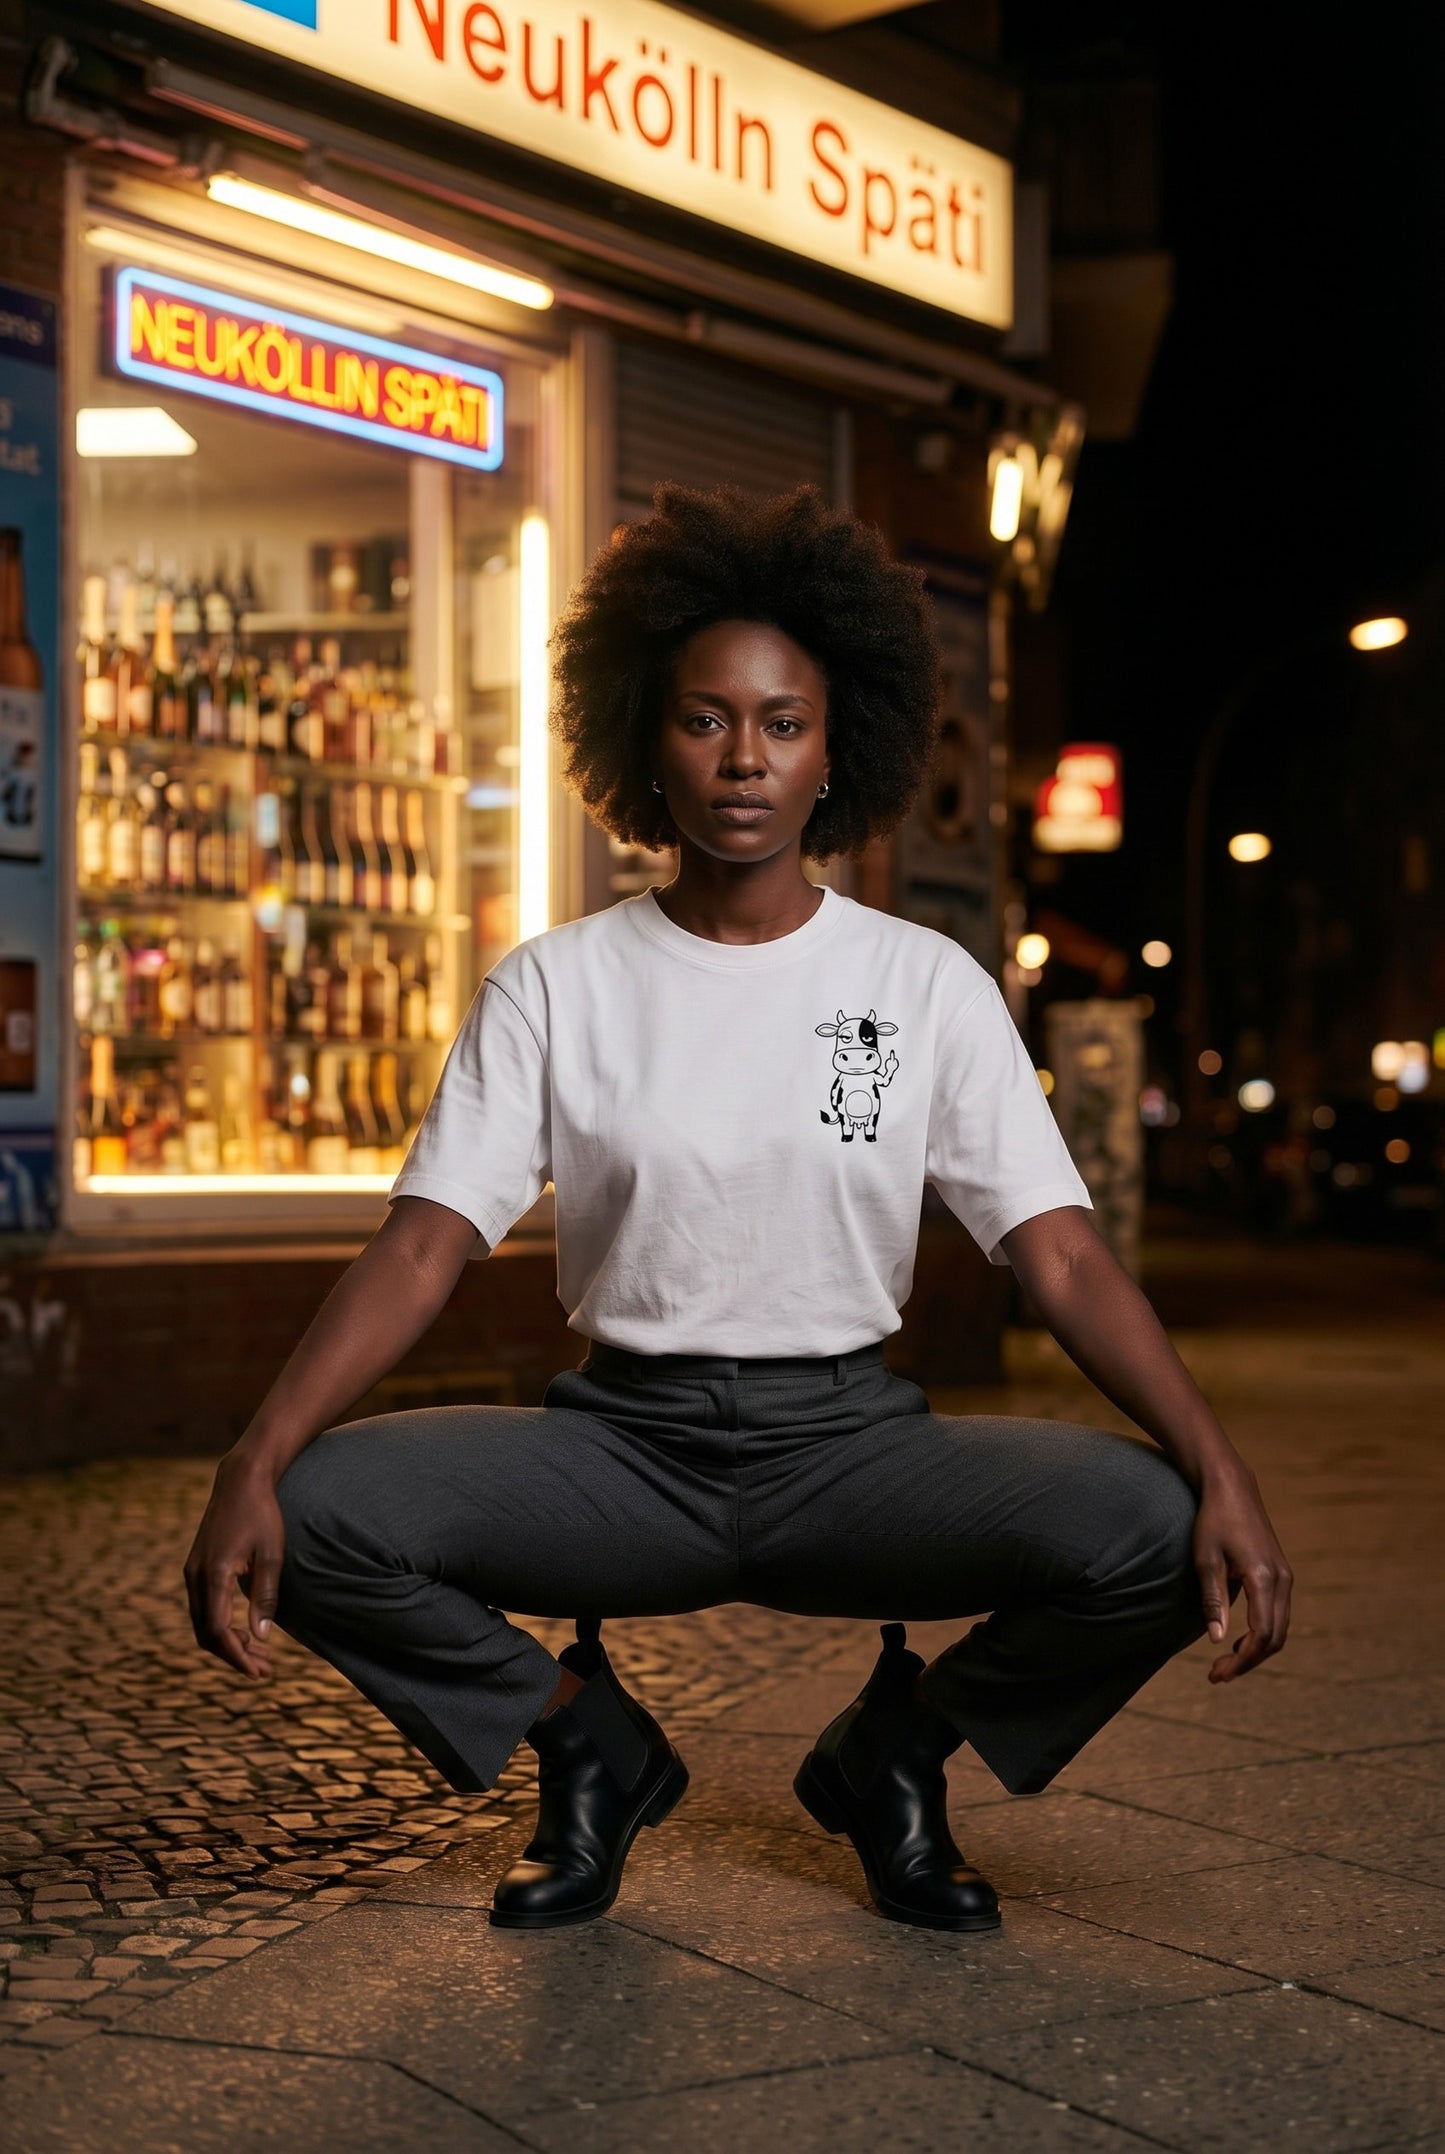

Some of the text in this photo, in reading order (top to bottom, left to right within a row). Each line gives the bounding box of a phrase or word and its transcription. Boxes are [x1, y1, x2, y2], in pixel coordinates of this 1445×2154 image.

[390, 0, 984, 274] Neukölln Späti
[382, 367, 490, 450] SPÄTI
